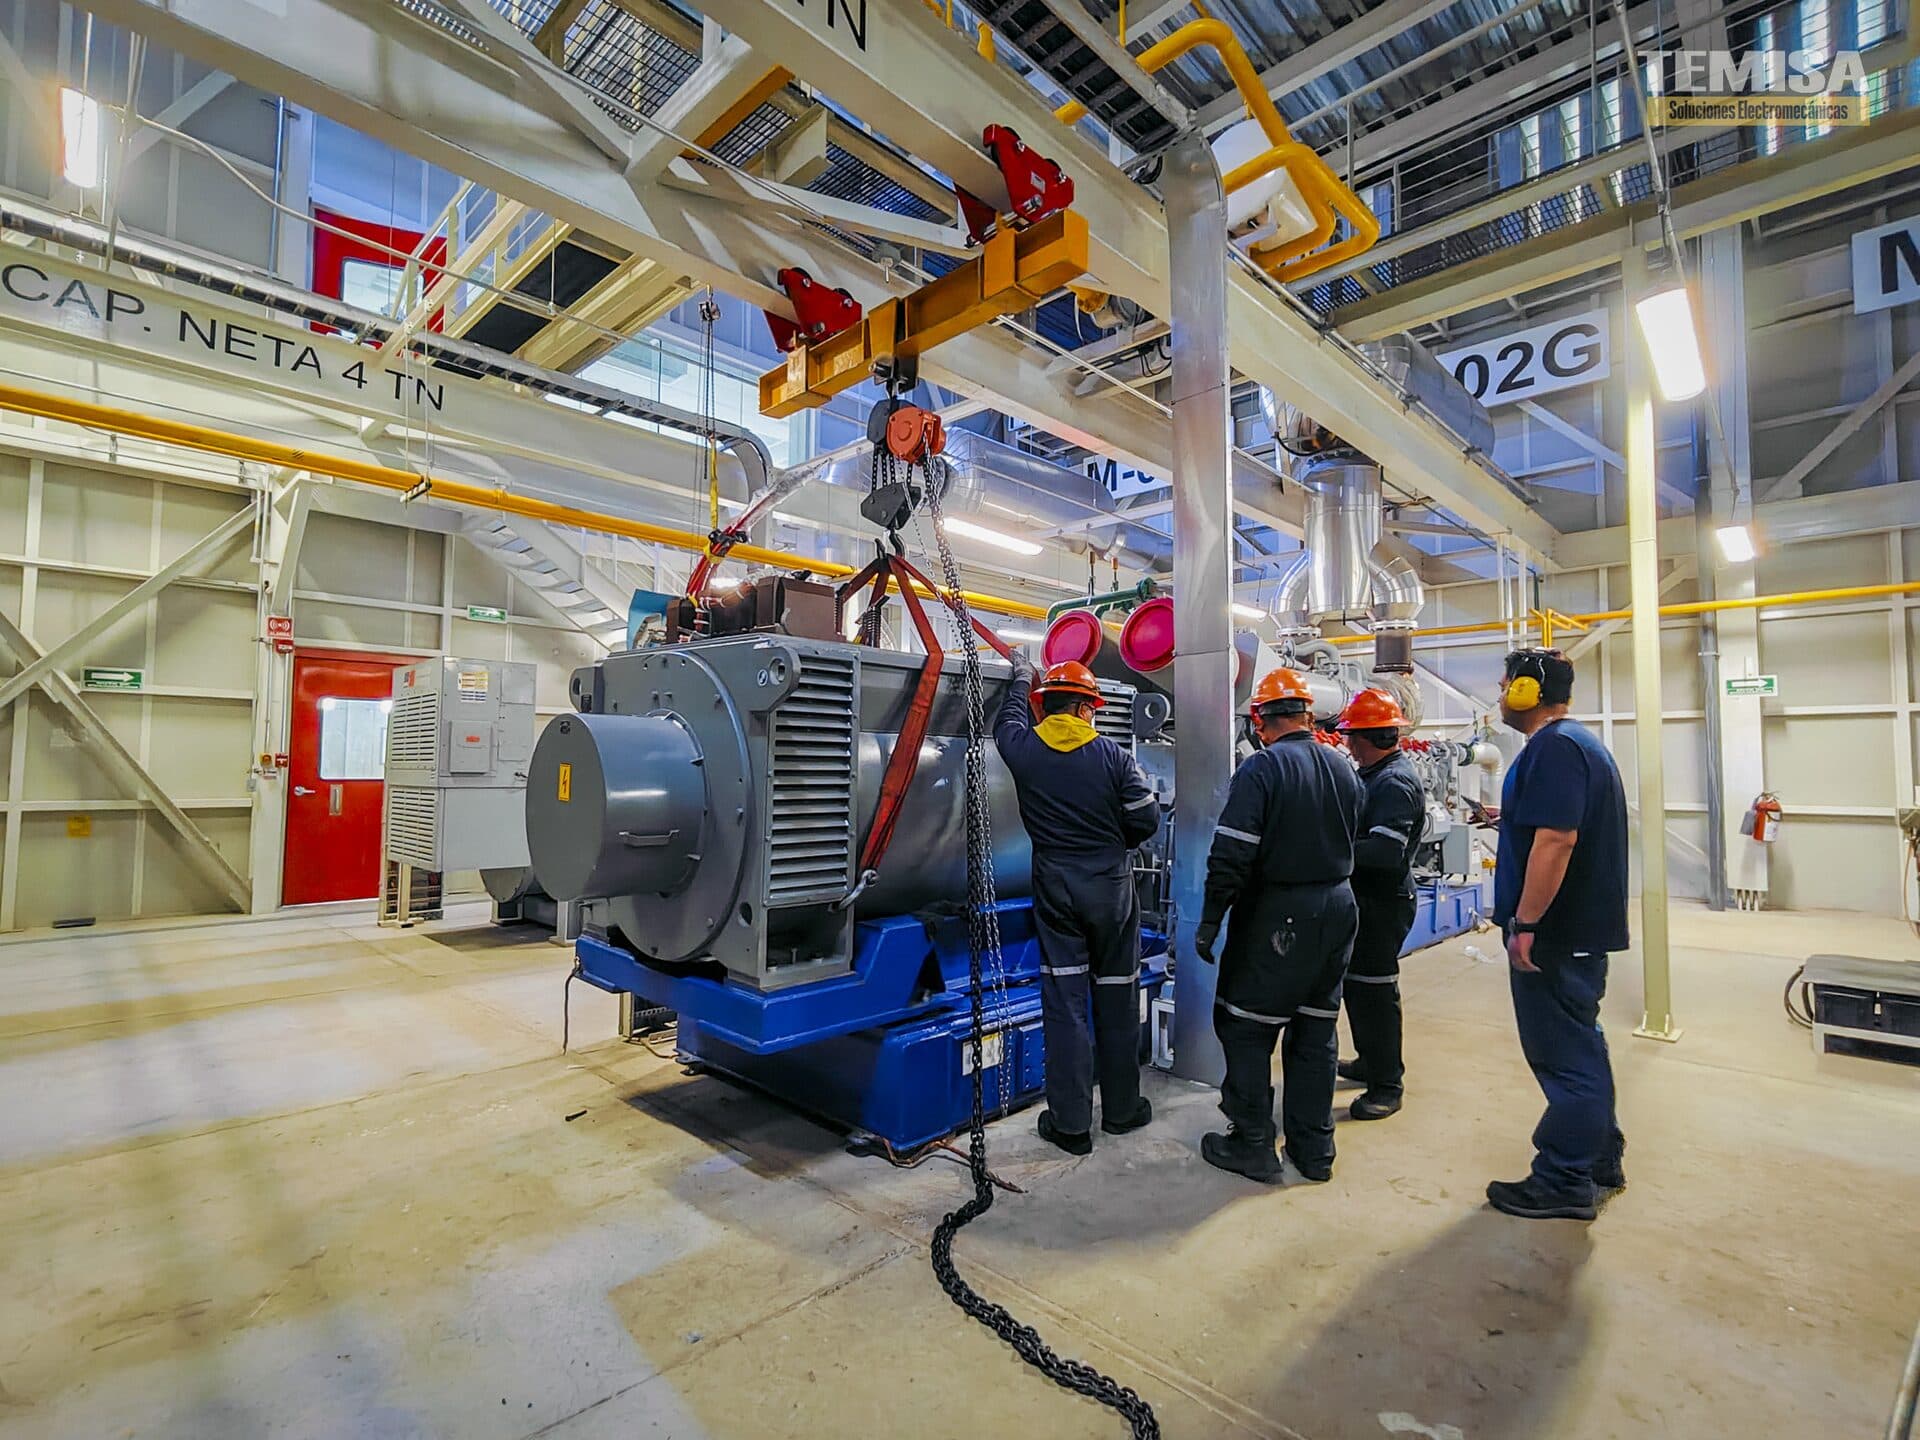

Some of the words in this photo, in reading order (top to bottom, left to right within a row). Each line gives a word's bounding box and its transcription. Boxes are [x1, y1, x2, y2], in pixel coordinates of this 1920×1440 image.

[797, 0, 866, 52] N
[2, 264, 151, 333] CAP.
[179, 310, 321, 379] NETA
[342, 360, 368, 390] 4
[386, 368, 444, 412] TN
